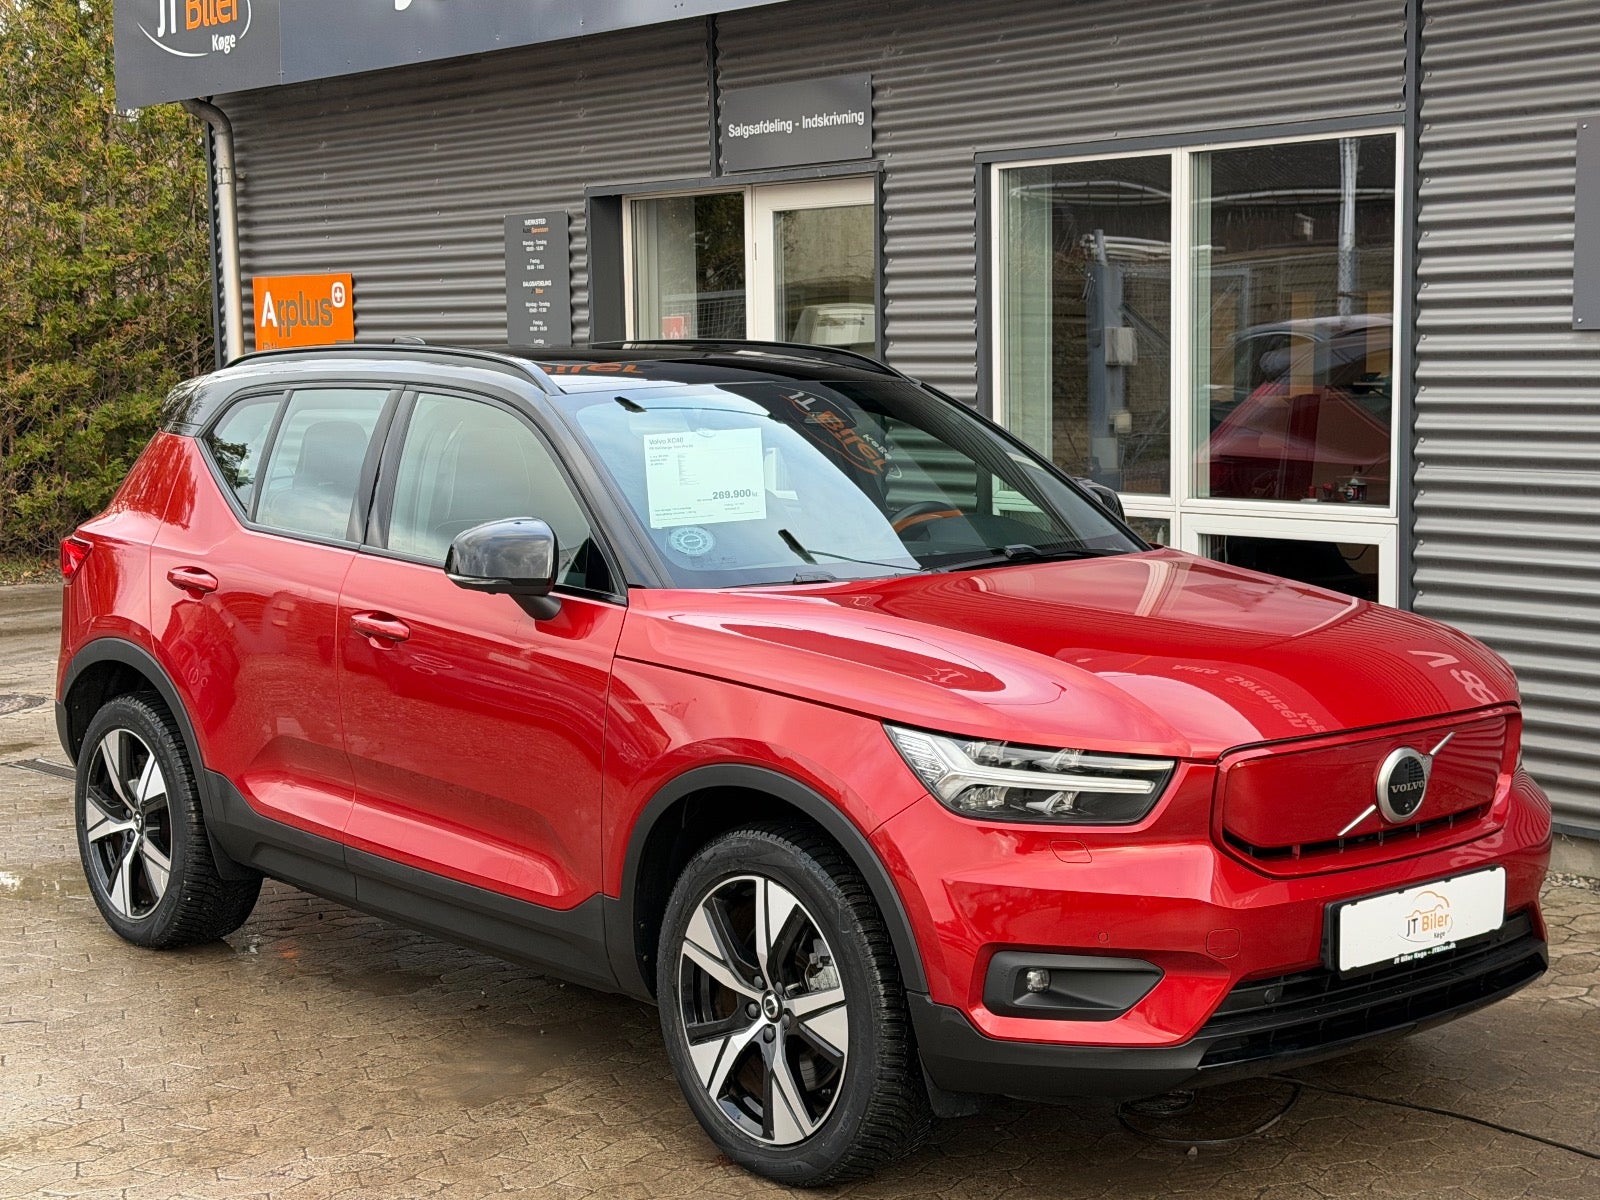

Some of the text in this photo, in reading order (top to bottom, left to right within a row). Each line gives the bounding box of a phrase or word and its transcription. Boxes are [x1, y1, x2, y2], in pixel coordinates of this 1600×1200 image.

[211, 34, 236, 54] Køge
[728, 119, 793, 139] Salgsafdeling
[802, 110, 865, 129] Indskrivning
[648, 438, 666, 446] Volvo
[712, 488, 751, 500] 269.900
[1390, 780, 1425, 794] VOLVO
[1406, 912, 1450, 938] JT Biler
